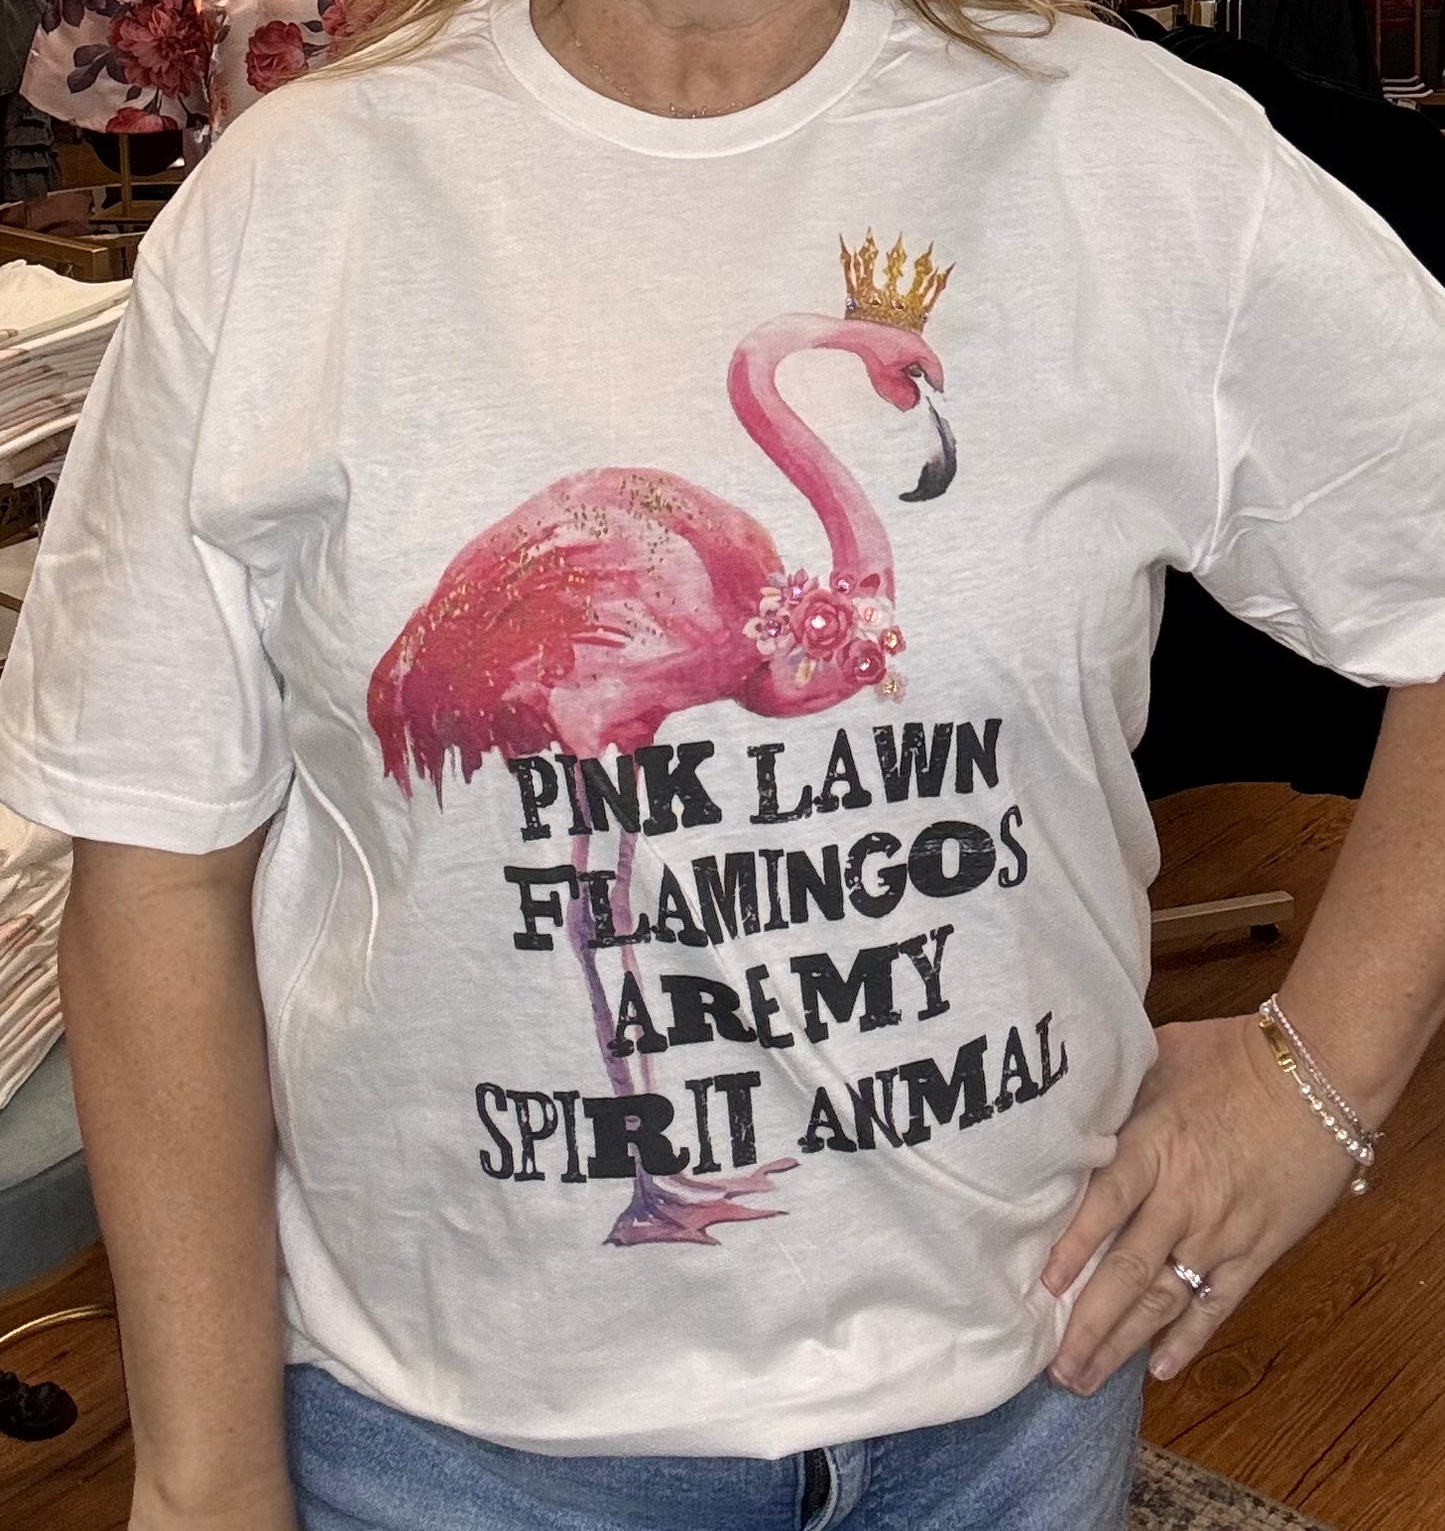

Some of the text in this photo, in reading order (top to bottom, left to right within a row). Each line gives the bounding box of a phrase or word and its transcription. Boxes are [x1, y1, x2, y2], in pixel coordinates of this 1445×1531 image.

[508, 718, 1002, 842] PINK LAWN
[504, 804, 1028, 951] FLAMINGOS
[606, 924, 954, 1058] ARE MY
[475, 1071, 761, 1184] SPIRIT
